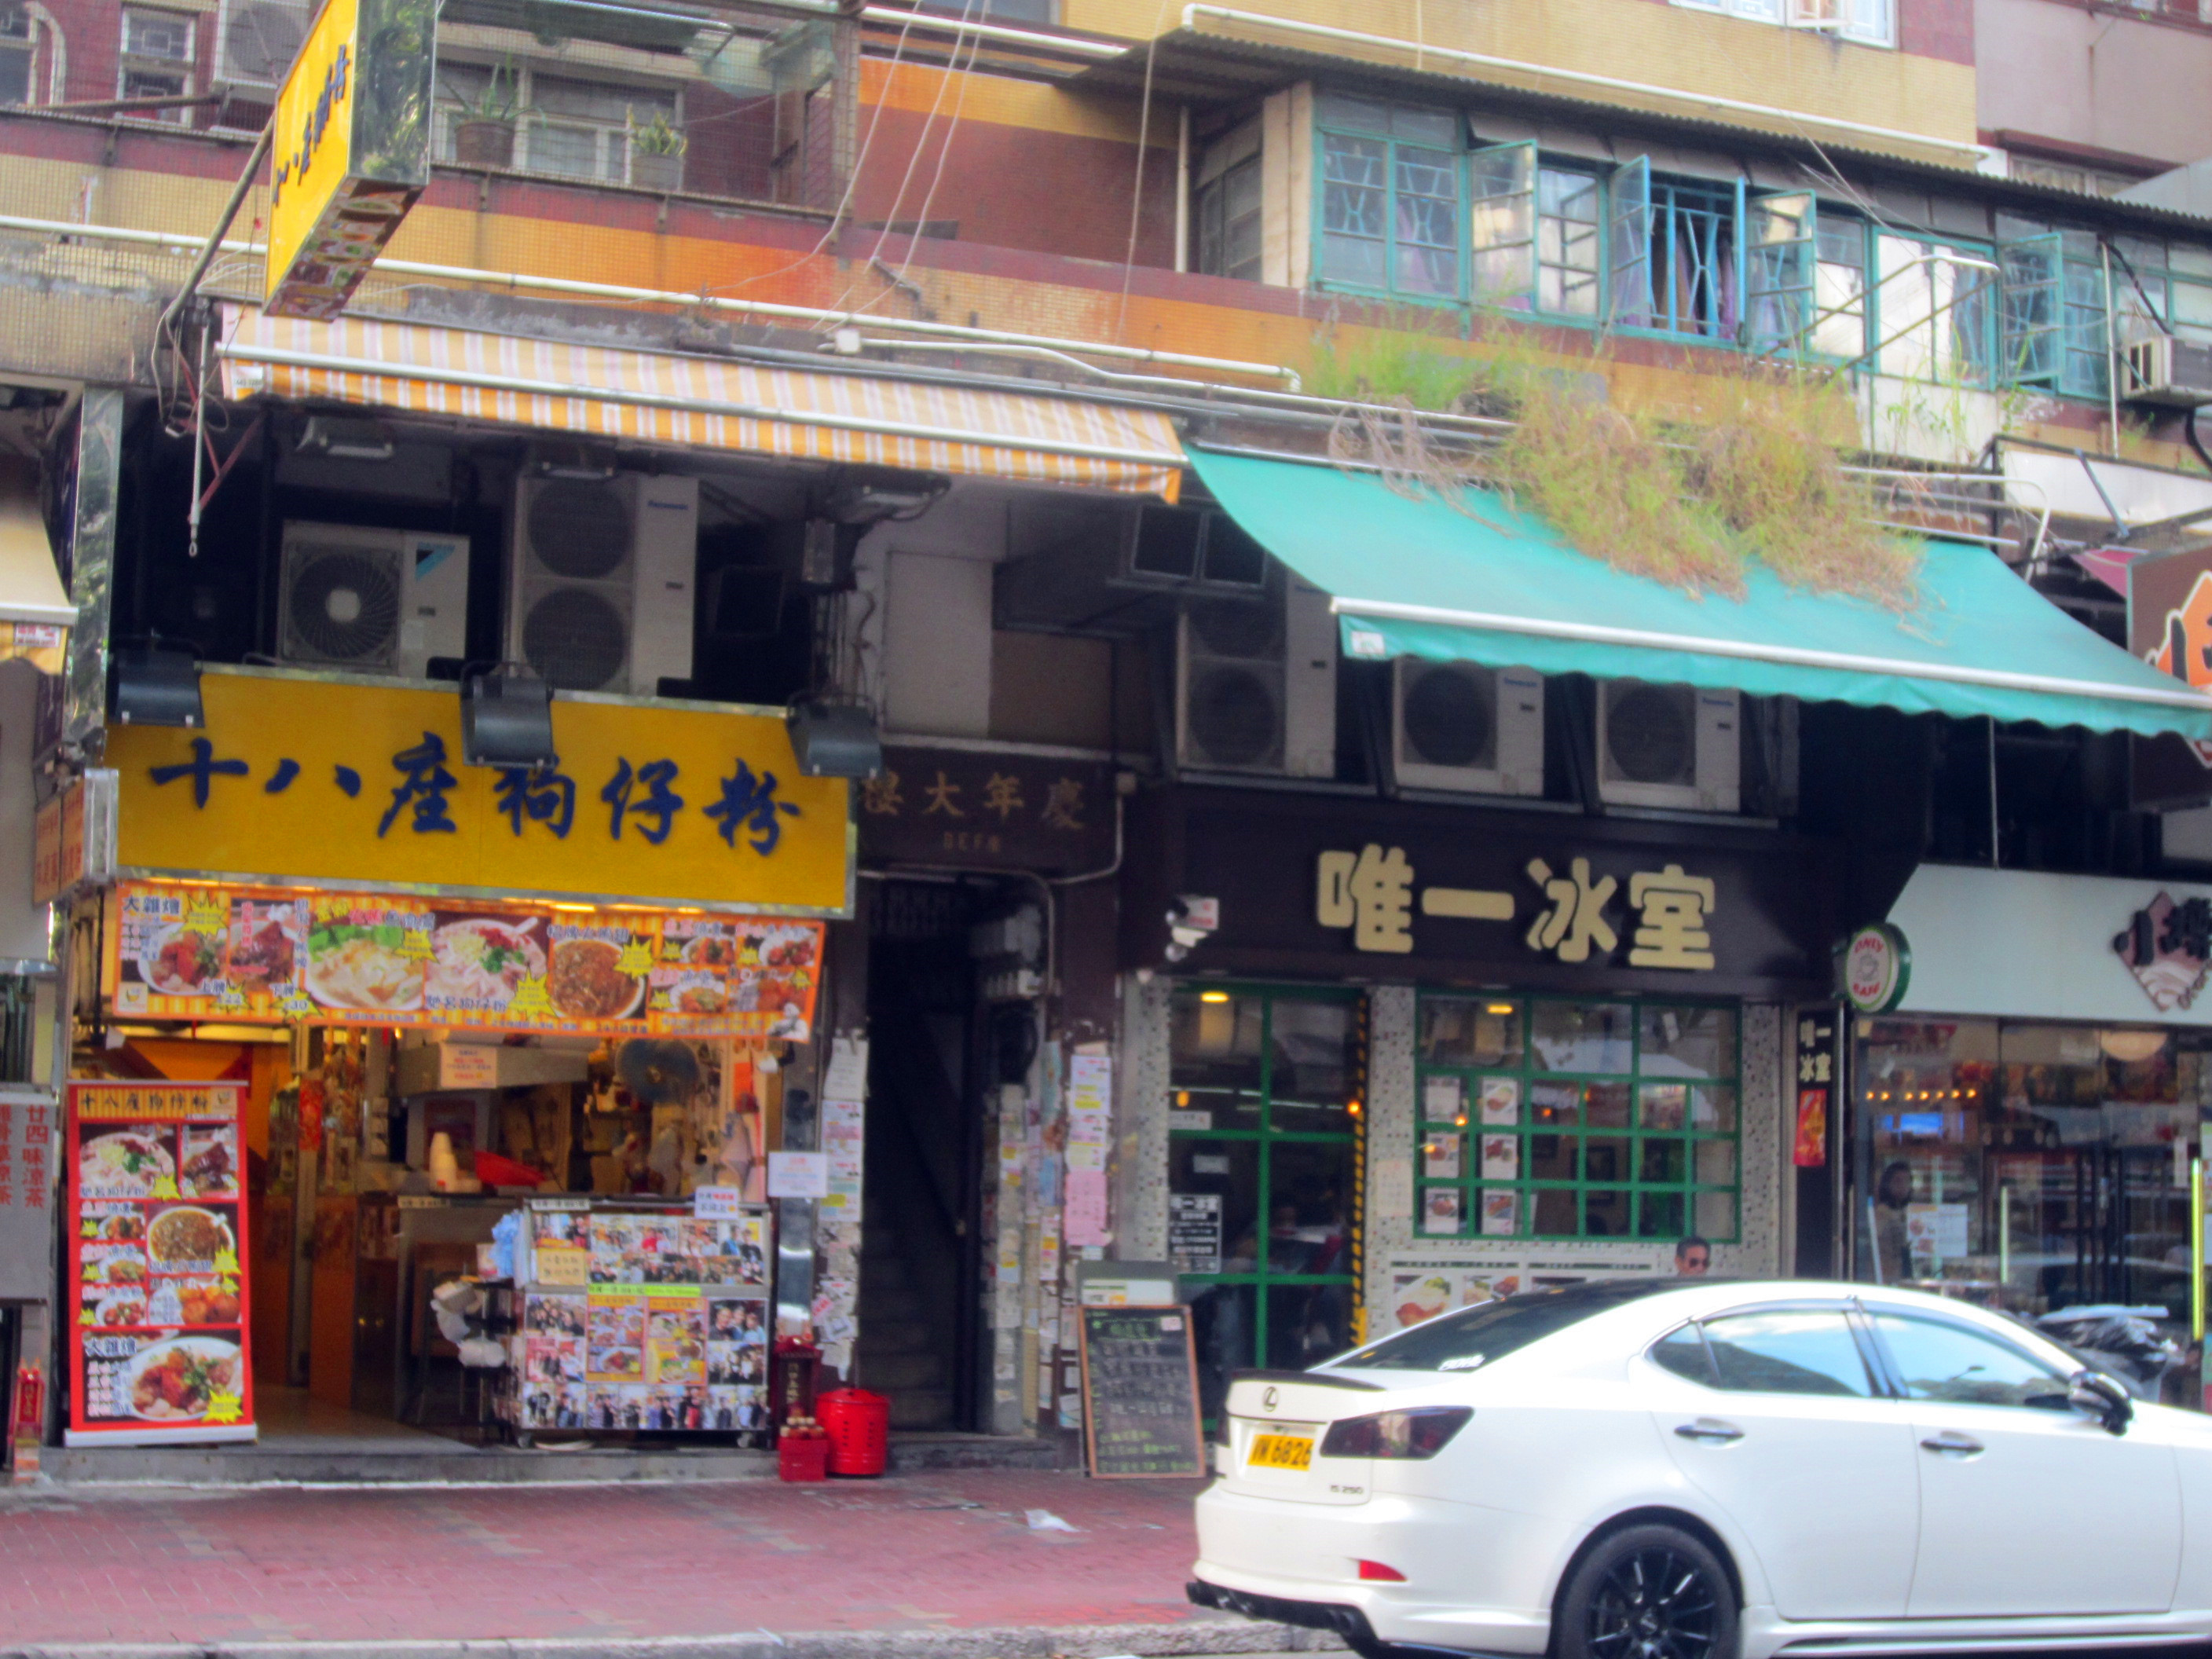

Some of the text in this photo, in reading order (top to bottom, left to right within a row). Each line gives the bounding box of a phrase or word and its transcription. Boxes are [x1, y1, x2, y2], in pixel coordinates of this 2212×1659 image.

[149, 731, 801, 856] 十八座狗仔粉
[1317, 843, 1716, 970] 唯一冰室
[1854, 937, 1884, 954] ONLY
